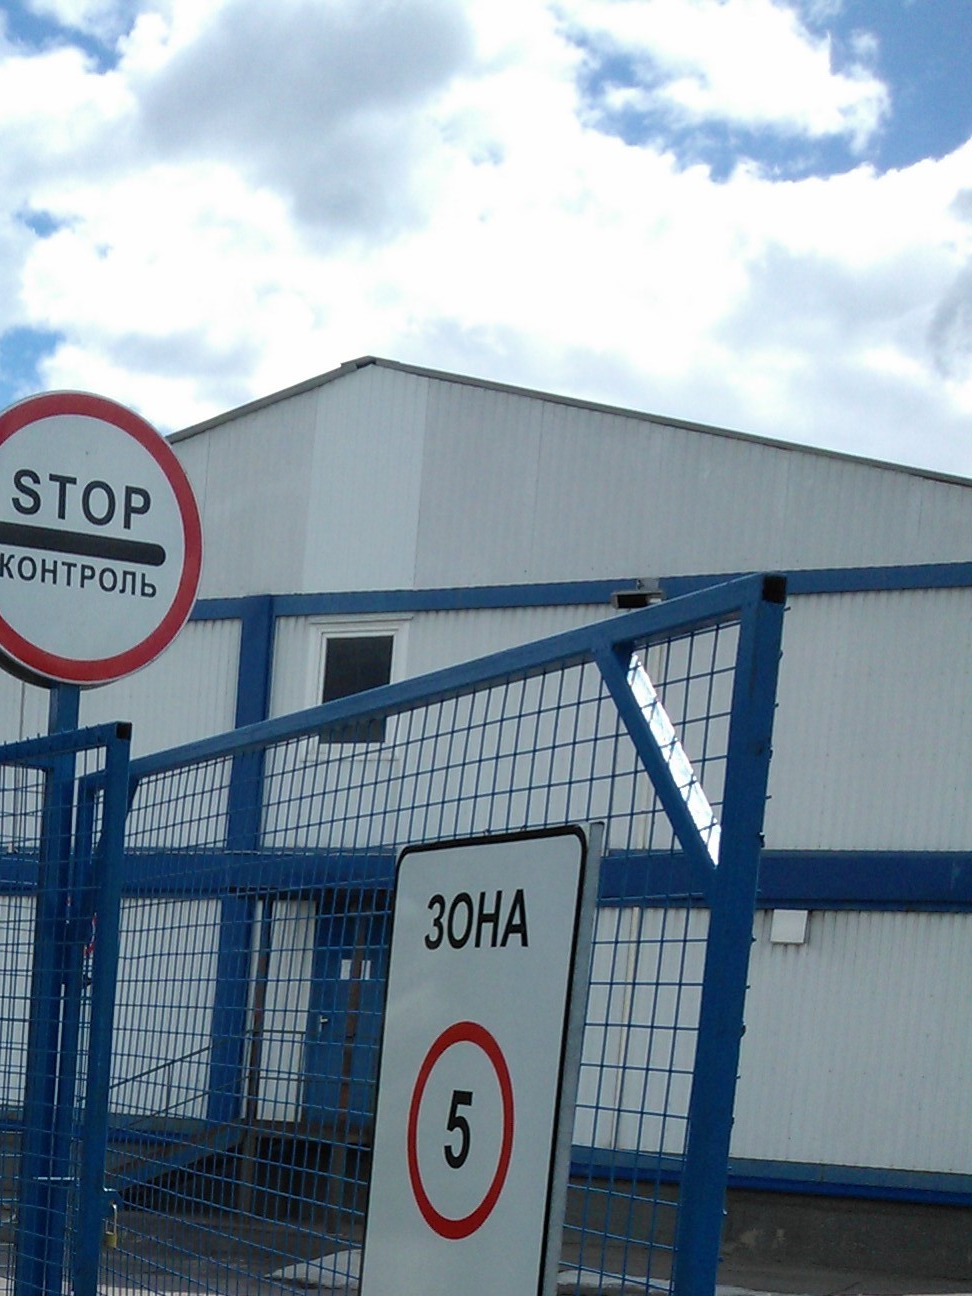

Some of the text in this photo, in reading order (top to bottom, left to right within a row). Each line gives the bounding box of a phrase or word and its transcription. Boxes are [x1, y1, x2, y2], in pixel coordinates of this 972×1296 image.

[11, 469, 151, 530] STOP
[0, 553, 157, 598] КОНТРОЛЬ
[424, 889, 528, 950] ЗОНА
[444, 1090, 473, 1169] 5
